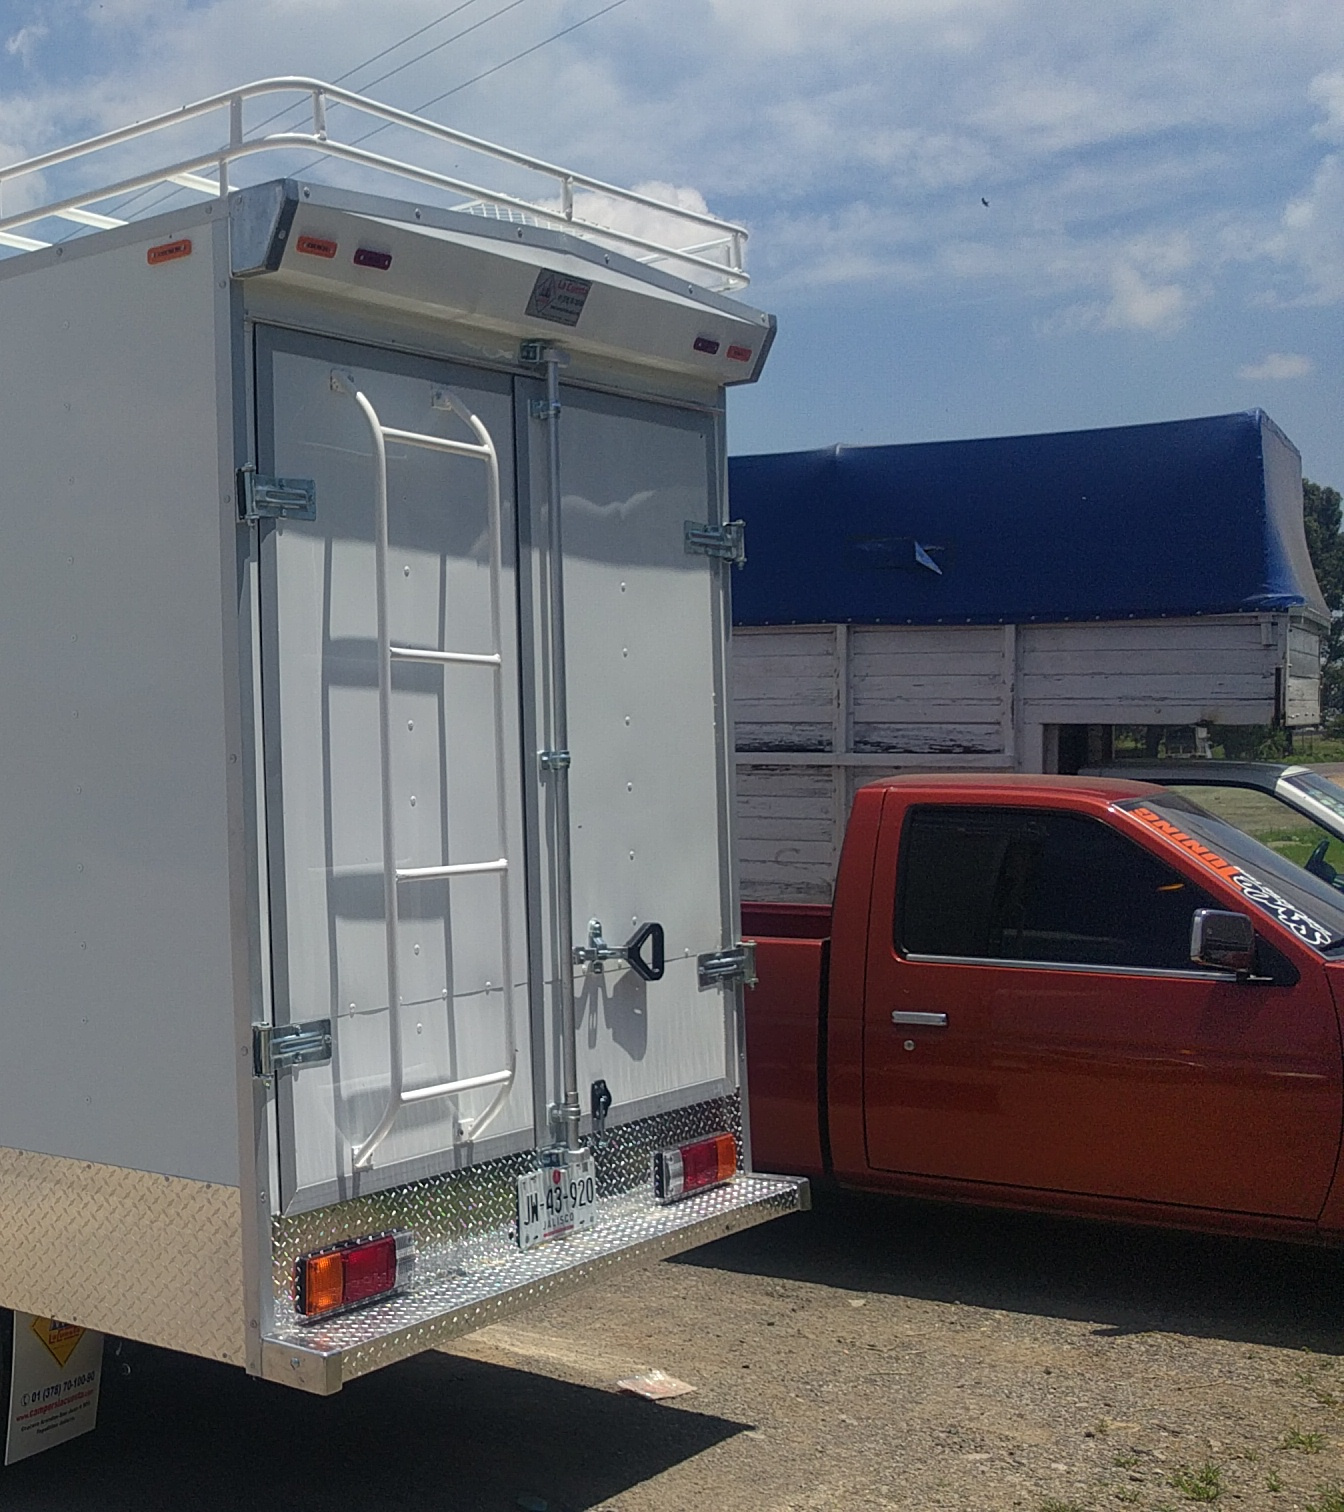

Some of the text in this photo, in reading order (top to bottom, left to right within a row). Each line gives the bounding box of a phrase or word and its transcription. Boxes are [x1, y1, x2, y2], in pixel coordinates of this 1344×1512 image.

[1128, 806, 1245, 891] TUNING
[523, 1176, 594, 1226] JW-43-920
[543, 1212, 575, 1231] JALISCO
[31, 1391, 41, 1403] 01
